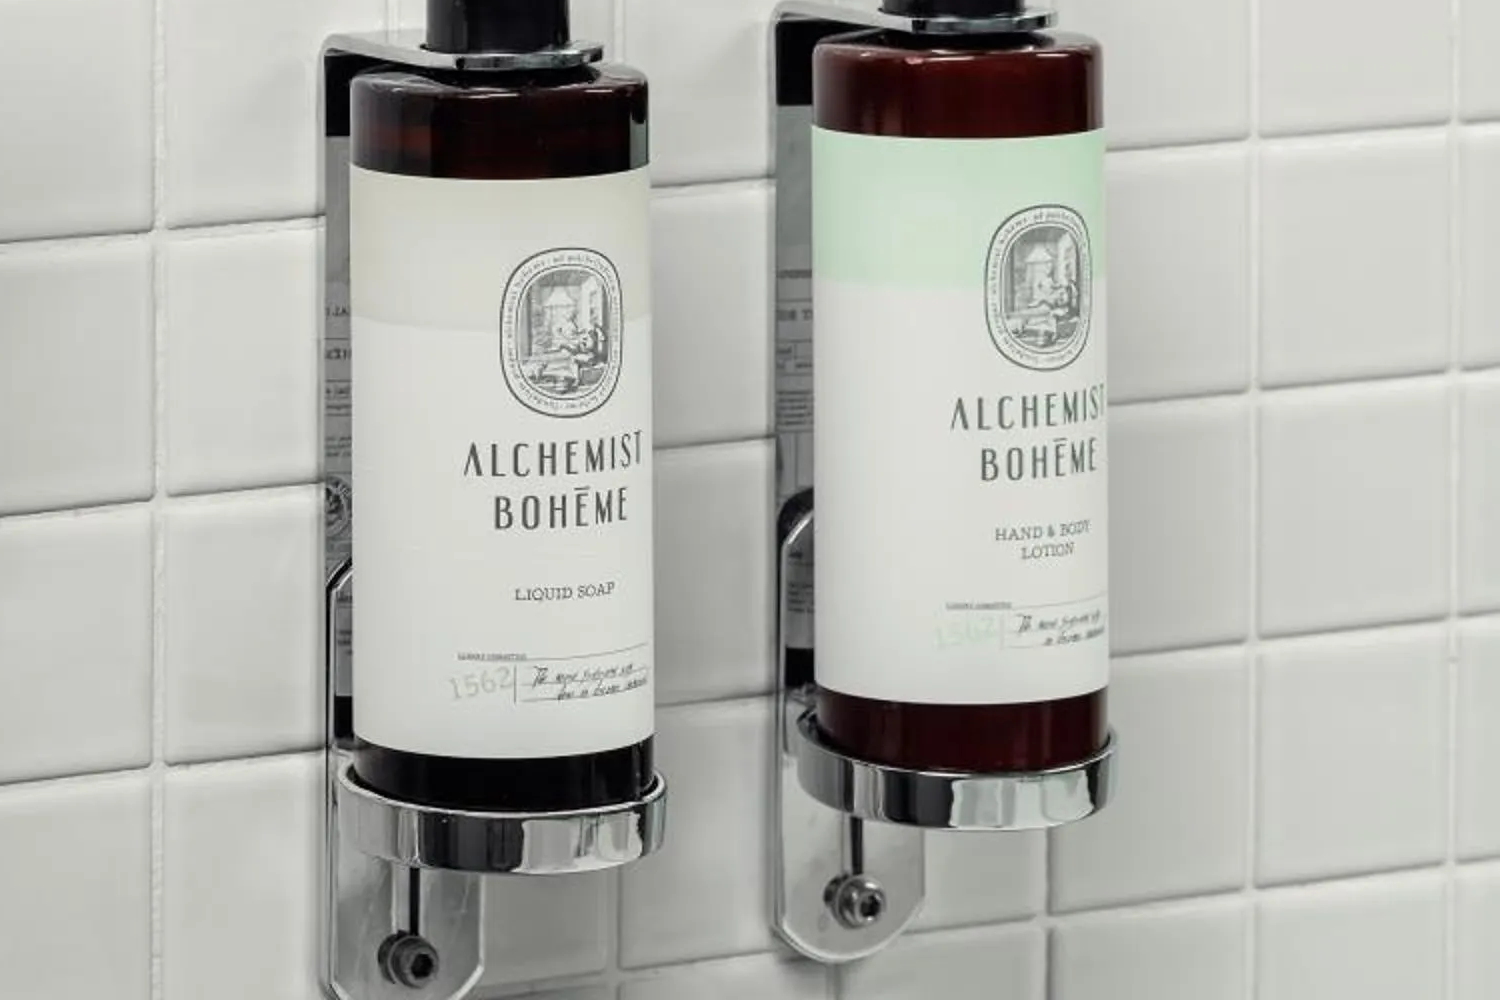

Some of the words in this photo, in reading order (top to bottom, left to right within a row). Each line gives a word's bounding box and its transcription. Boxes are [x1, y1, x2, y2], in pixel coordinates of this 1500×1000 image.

[951, 382, 1105, 431] ALCHEMIST
[463, 429, 642, 477] ALCHEMIST
[995, 526, 1043, 541] HAND
[1047, 524, 1055, 538] &
[1059, 519, 1091, 537] BODY
[1021, 541, 1075, 560] LOTION
[515, 587, 573, 602] LIQUID
[577, 581, 616, 598] SOAP
